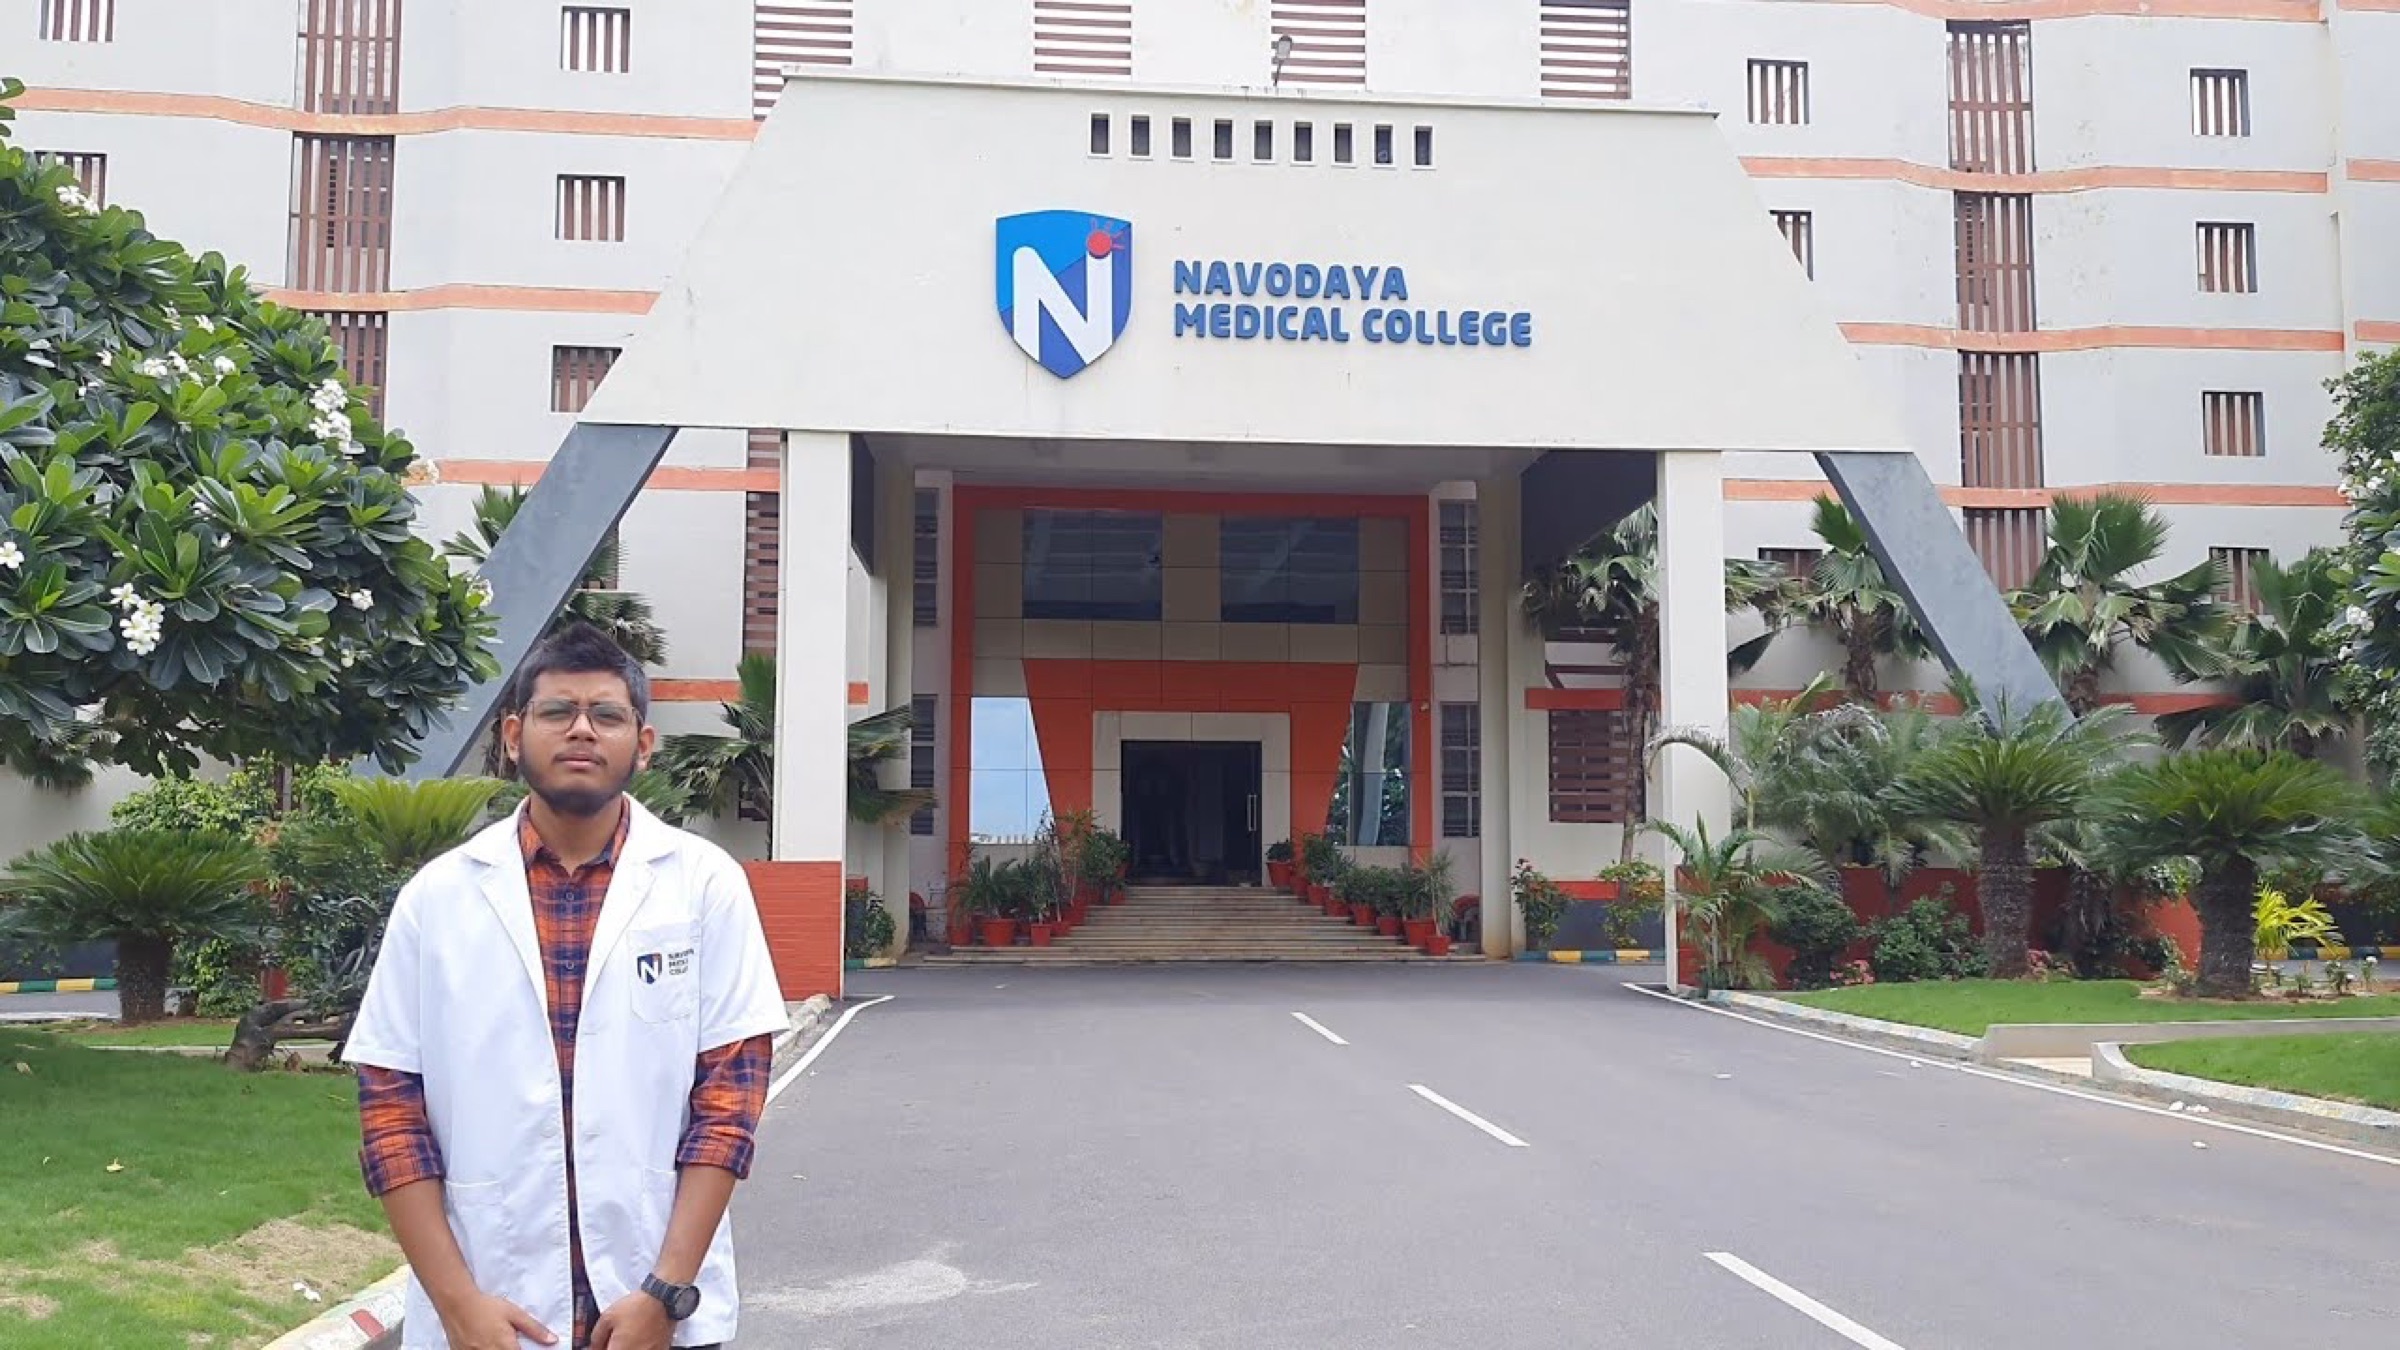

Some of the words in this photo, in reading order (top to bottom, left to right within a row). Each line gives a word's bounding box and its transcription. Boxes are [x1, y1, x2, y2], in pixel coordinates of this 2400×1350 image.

[1173, 260, 1409, 300] NAVODAYA
[1173, 302, 1350, 342] MEDICAL
[1362, 308, 1532, 348] COLLEGE
